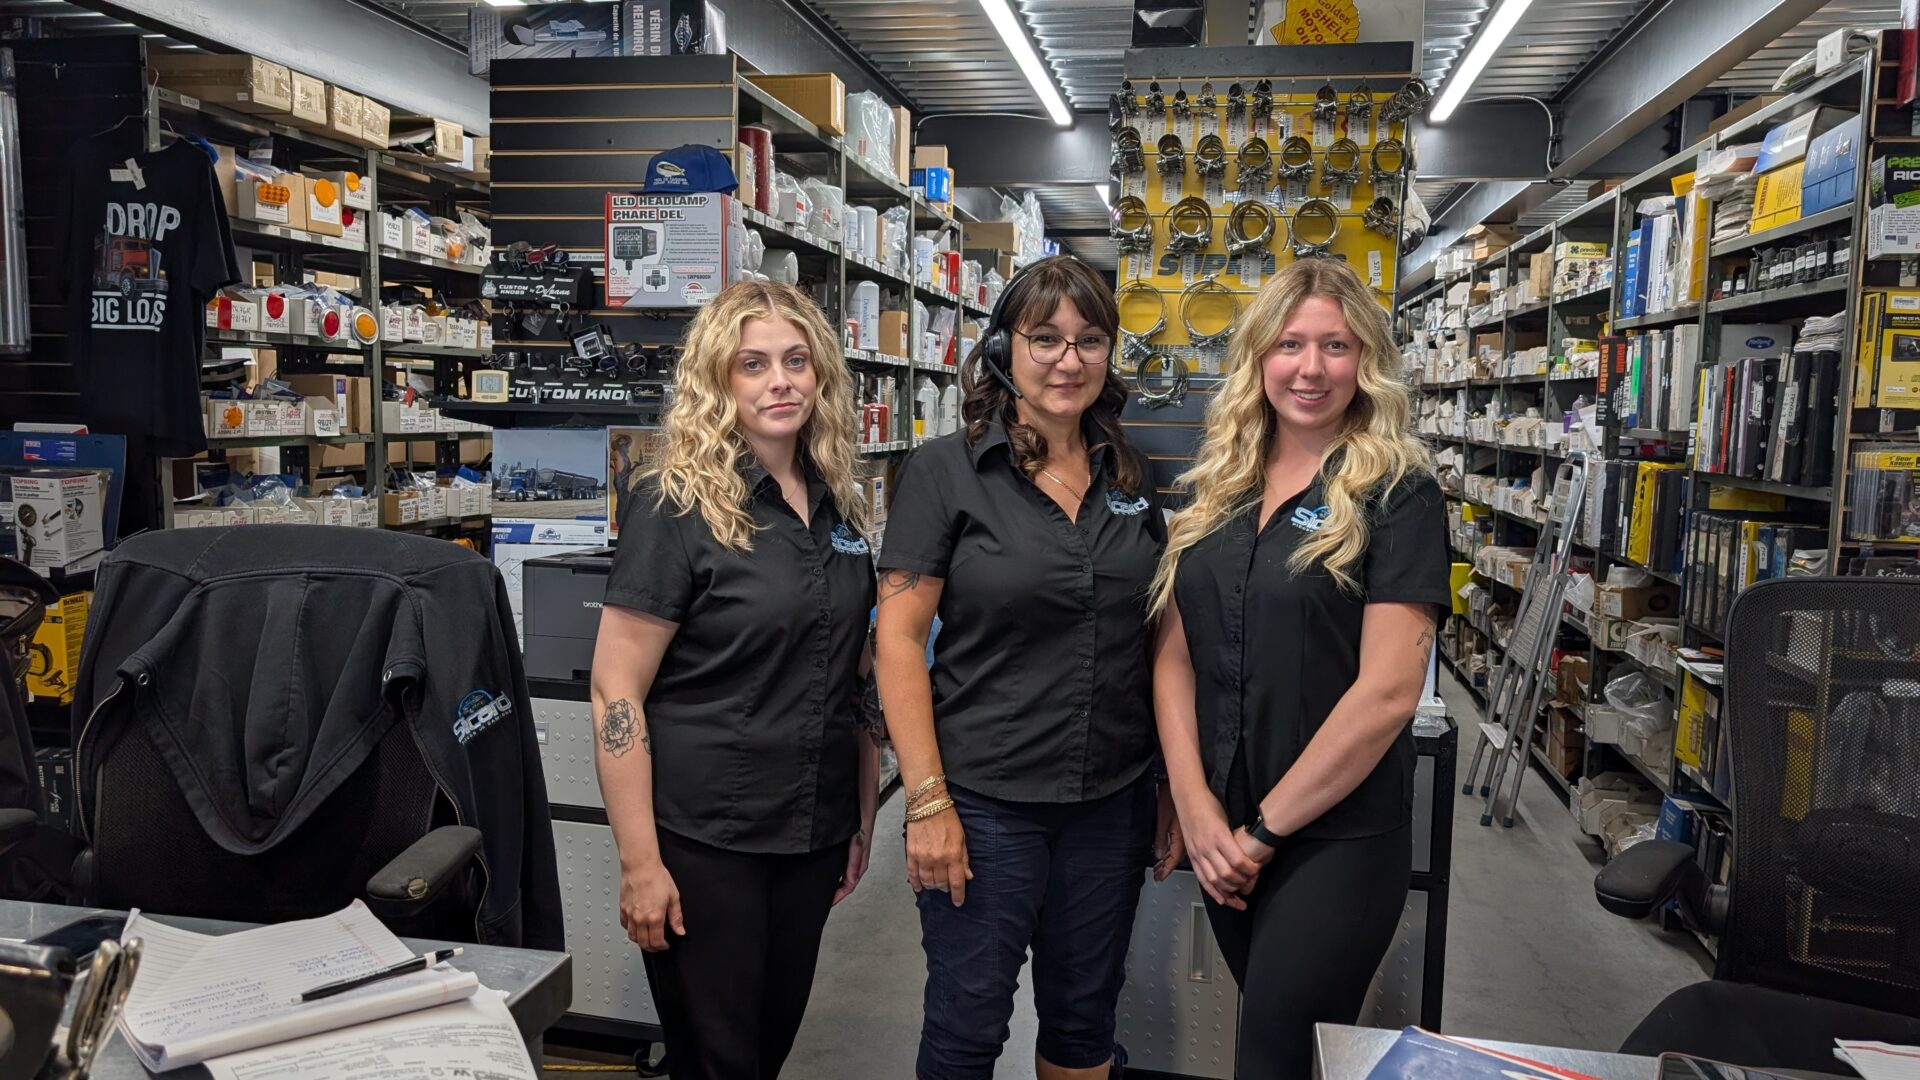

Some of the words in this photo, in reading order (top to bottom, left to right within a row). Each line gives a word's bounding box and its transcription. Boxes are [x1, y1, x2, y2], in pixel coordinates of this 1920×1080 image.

[612, 4, 620, 32] Capacité
[650, 9, 662, 43] VÉRIN
[1299, 8, 1327, 44] MOTO
[1312, 8, 1349, 42] SHELL
[613, 196, 635, 206] LED
[640, 196, 708, 206] HEADLAMP
[613, 210, 657, 219] PHARE
[660, 210, 684, 219] DEL
[106, 202, 181, 241] DROP
[584, 389, 629, 400] KNO
